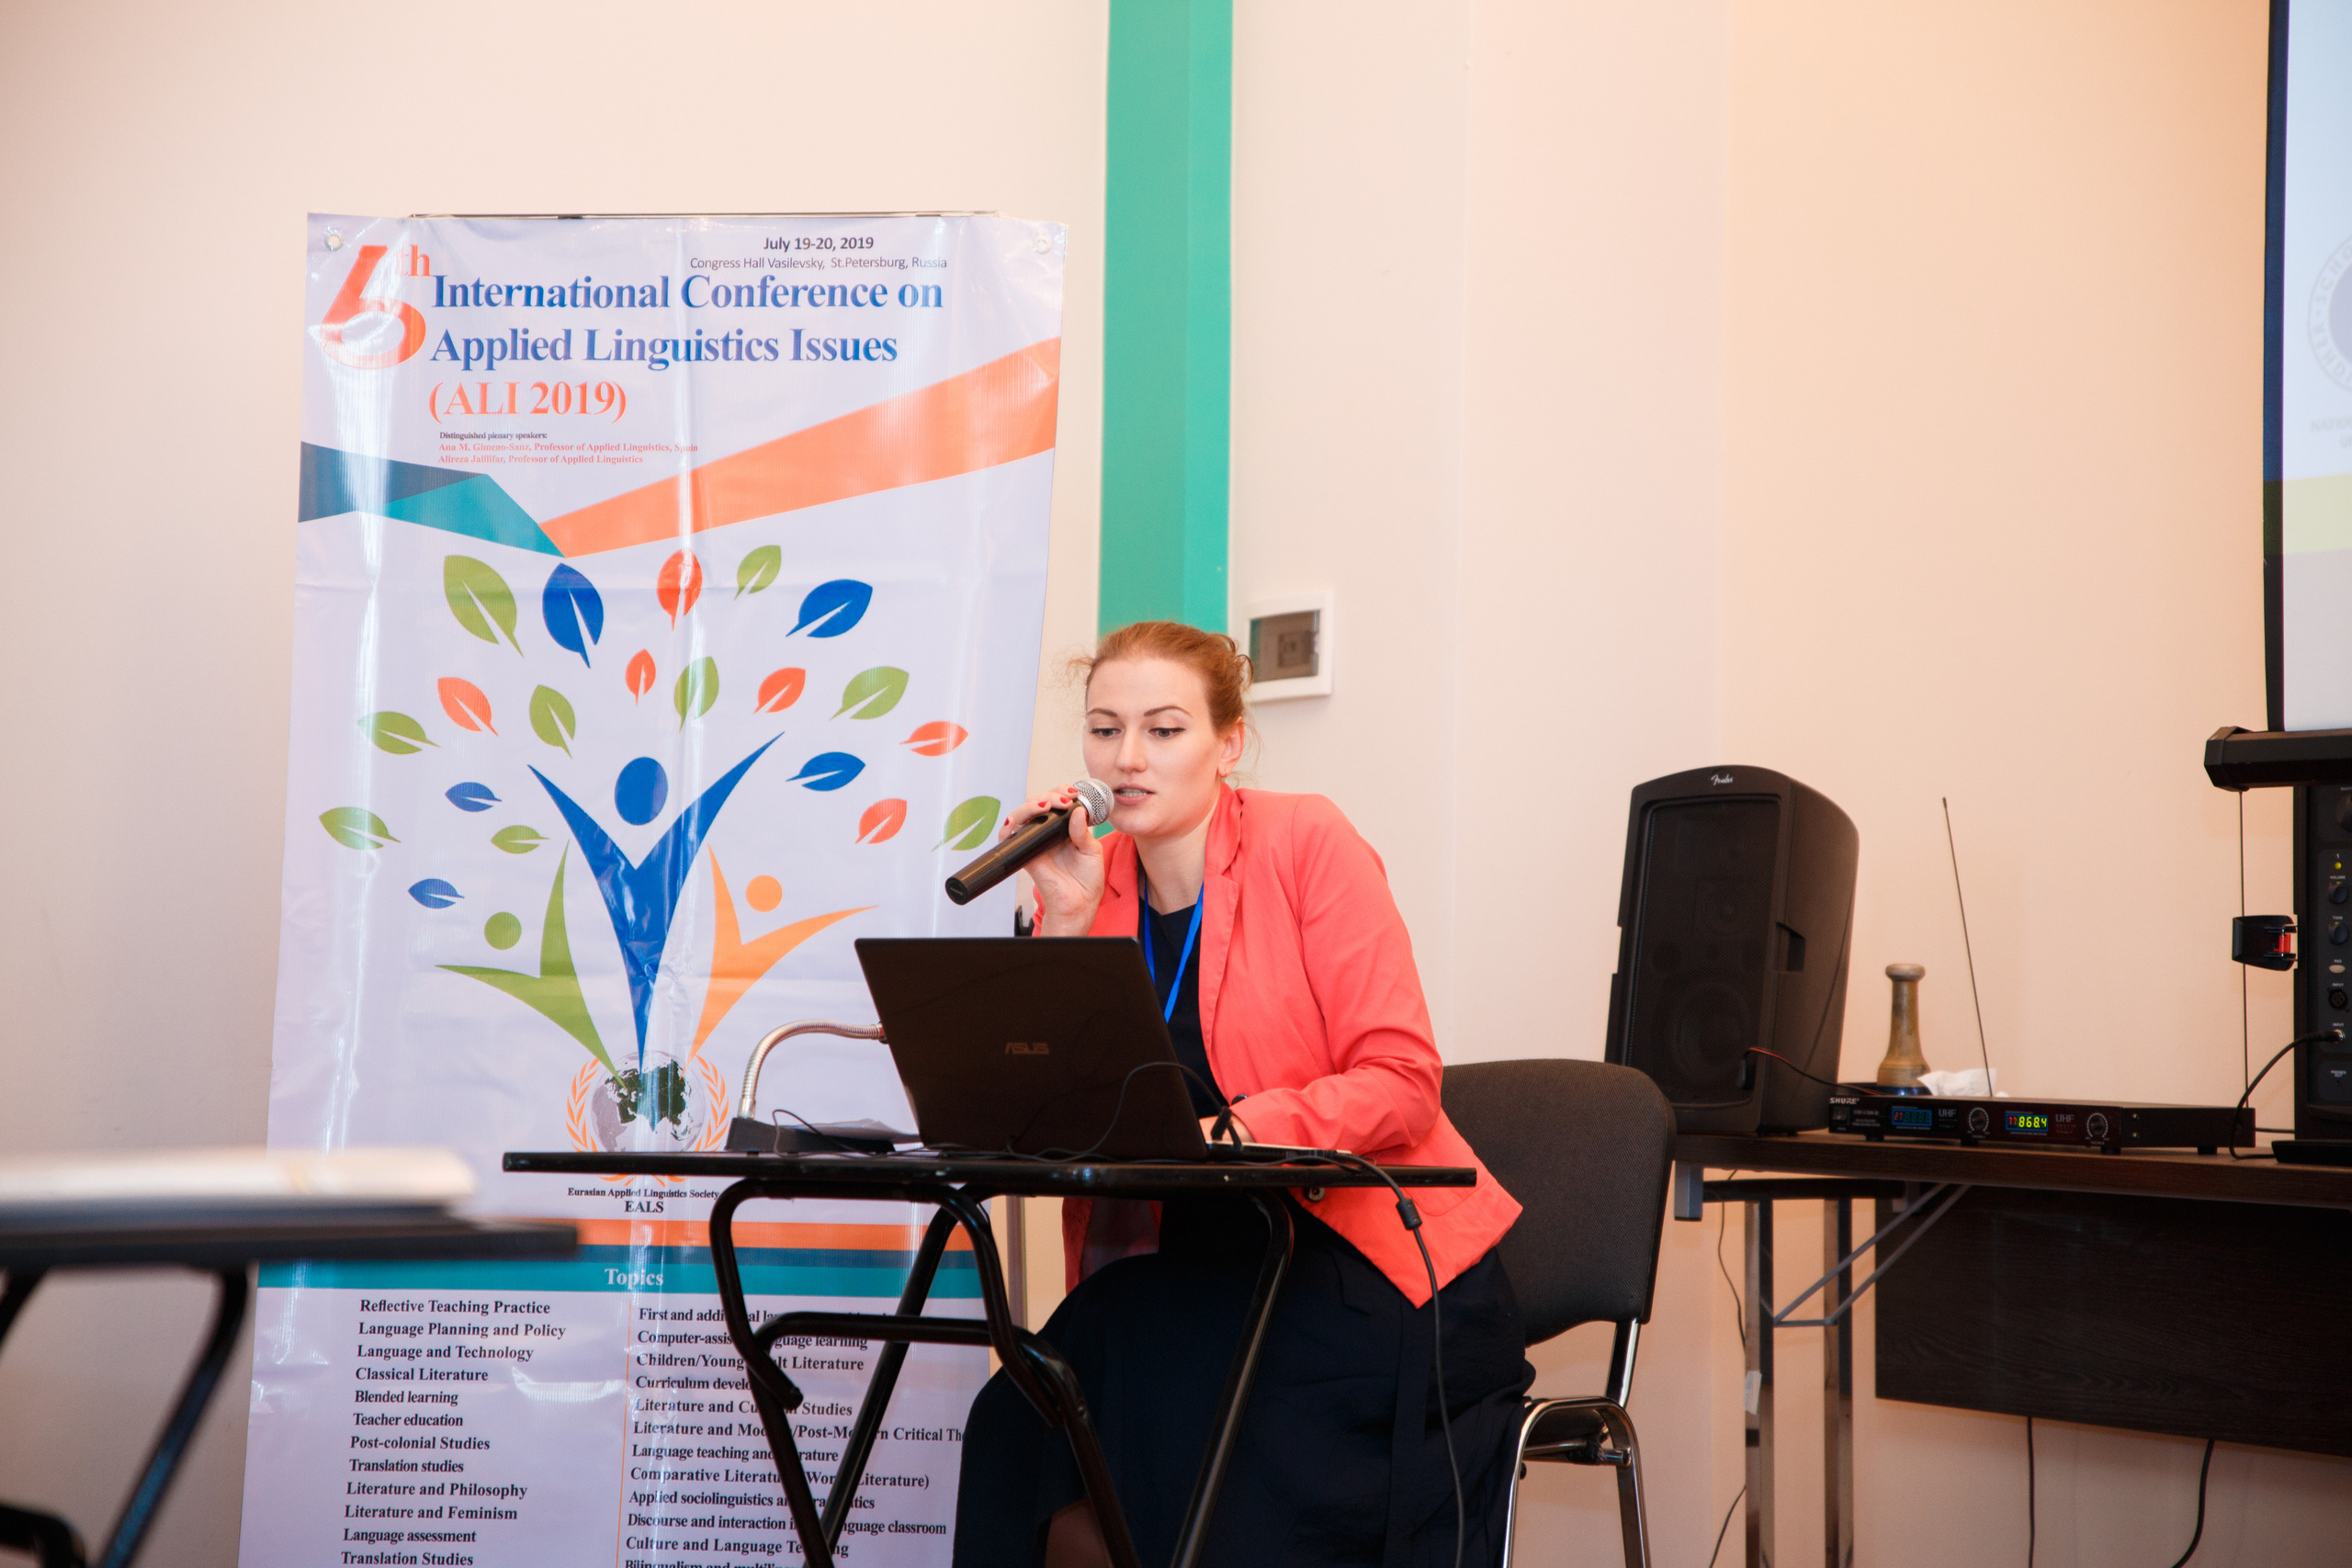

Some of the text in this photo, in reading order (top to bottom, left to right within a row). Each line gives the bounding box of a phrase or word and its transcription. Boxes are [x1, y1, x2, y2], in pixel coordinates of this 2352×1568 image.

[763, 236, 874, 253] July 19-20, 2019
[690, 256, 947, 270] Congress Hall Vasilevsky, St.Petersburg, Russia
[432, 275, 944, 309] International Conference on
[429, 328, 899, 371] Applied Linguistics Issues
[429, 381, 627, 424] (ALI 2019)
[439, 432, 548, 441] Distinguished plenary speakers:
[438, 443, 698, 453] Ana M. Gimeno-Sanz, Professor of Applied Linguistics, Spain
[508, 455, 547, 463] Professor
[549, 456, 560, 464] of
[560, 456, 594, 465] Applied
[596, 456, 643, 465] Linguistics
[1005, 1043, 1050, 1055] ASUS
[1939, 1109, 1957, 1117] UHF
[2055, 1114, 2075, 1122] UHF
[2018, 1116, 2047, 1128] 868.4
[568, 1188, 720, 1200] Eurasian Applied Linguistics Society
[624, 1201, 664, 1213] EALS
[605, 1269, 663, 1290] Topics
[360, 1300, 550, 1316] Reflective Teaching Practice
[639, 1308, 668, 1321] First
[671, 1309, 693, 1321] and
[696, 1309, 760, 1322] addial
[358, 1322, 566, 1339] Language Planning and Policy
[357, 1345, 534, 1361] Language and Technology
[636, 1353, 745, 1371] Children/Young
[792, 1357, 864, 1371] Literature
[356, 1368, 489, 1382] Classical Literature
[635, 1376, 709, 1390] Curriculum
[355, 1391, 458, 1406] Blended learning
[635, 1399, 704, 1413] Literature
[708, 1401, 734, 1413] and
[802, 1403, 853, 1416] Studies
[353, 1413, 464, 1427] Teacher education
[634, 1421, 703, 1435] Literature
[707, 1424, 733, 1436] and
[893, 1427, 943, 1441] Critical
[350, 1436, 491, 1450] Post-colonial Studies
[632, 1444, 694, 1461] Language
[696, 1446, 749, 1462] teaching
[349, 1459, 464, 1472] Translation studies
[630, 1467, 720, 1484] Comparative
[346, 1482, 527, 1500] Literature and Philosophy
[628, 1491, 678, 1506] Applied
[681, 1492, 774, 1508] sociolinguistics
[345, 1505, 517, 1519] Literature and Feminism
[628, 1513, 688, 1528] Discourse
[691, 1516, 715, 1529] and
[718, 1516, 786, 1530] interaction
[888, 1519, 946, 1535] classroom
[343, 1528, 477, 1545] Language assessment
[626, 1537, 679, 1551] Culture
[684, 1539, 708, 1551] and
[714, 1539, 783, 1556] Language
[341, 1551, 473, 1566] Translation Studies
